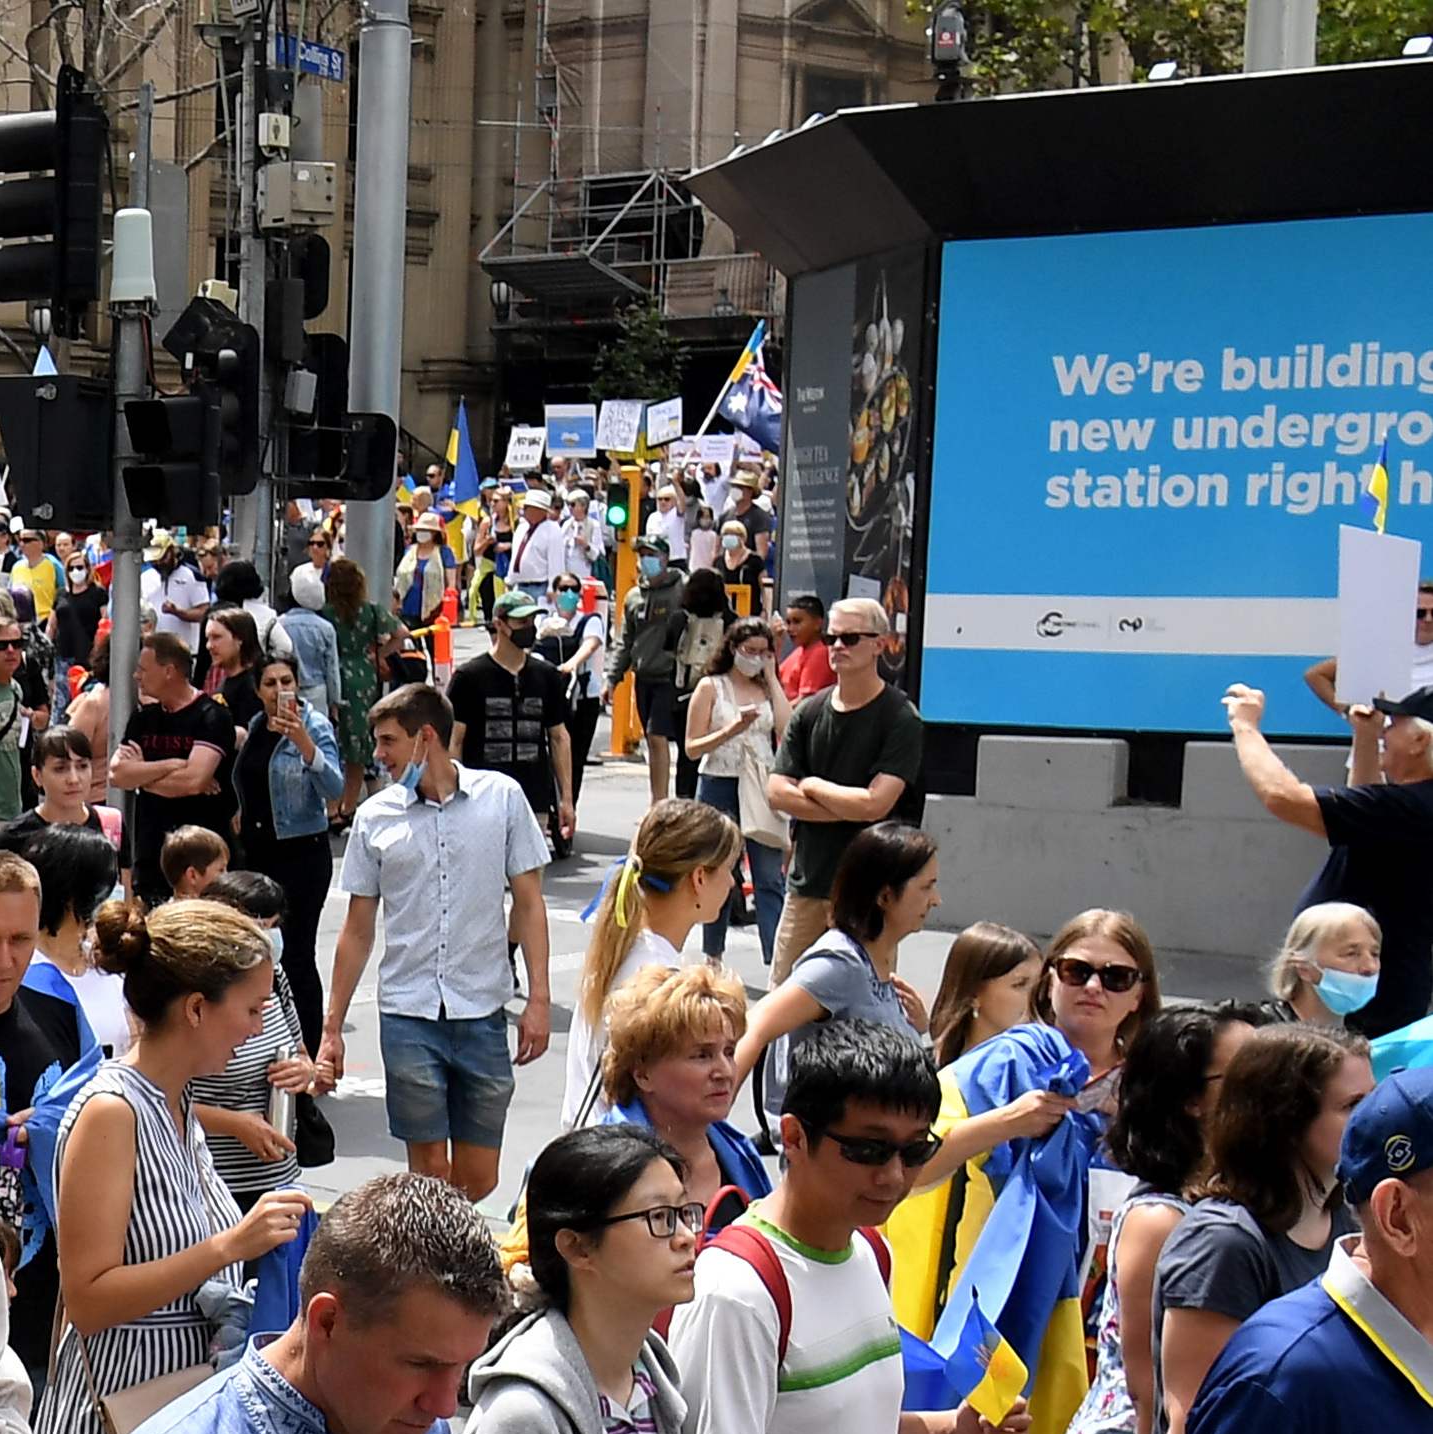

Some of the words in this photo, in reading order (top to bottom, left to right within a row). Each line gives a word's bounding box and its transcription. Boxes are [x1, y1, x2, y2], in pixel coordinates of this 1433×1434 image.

[1052, 352, 1205, 397] We're
[1048, 417, 1155, 452] new
[1045, 463, 1229, 509] station
